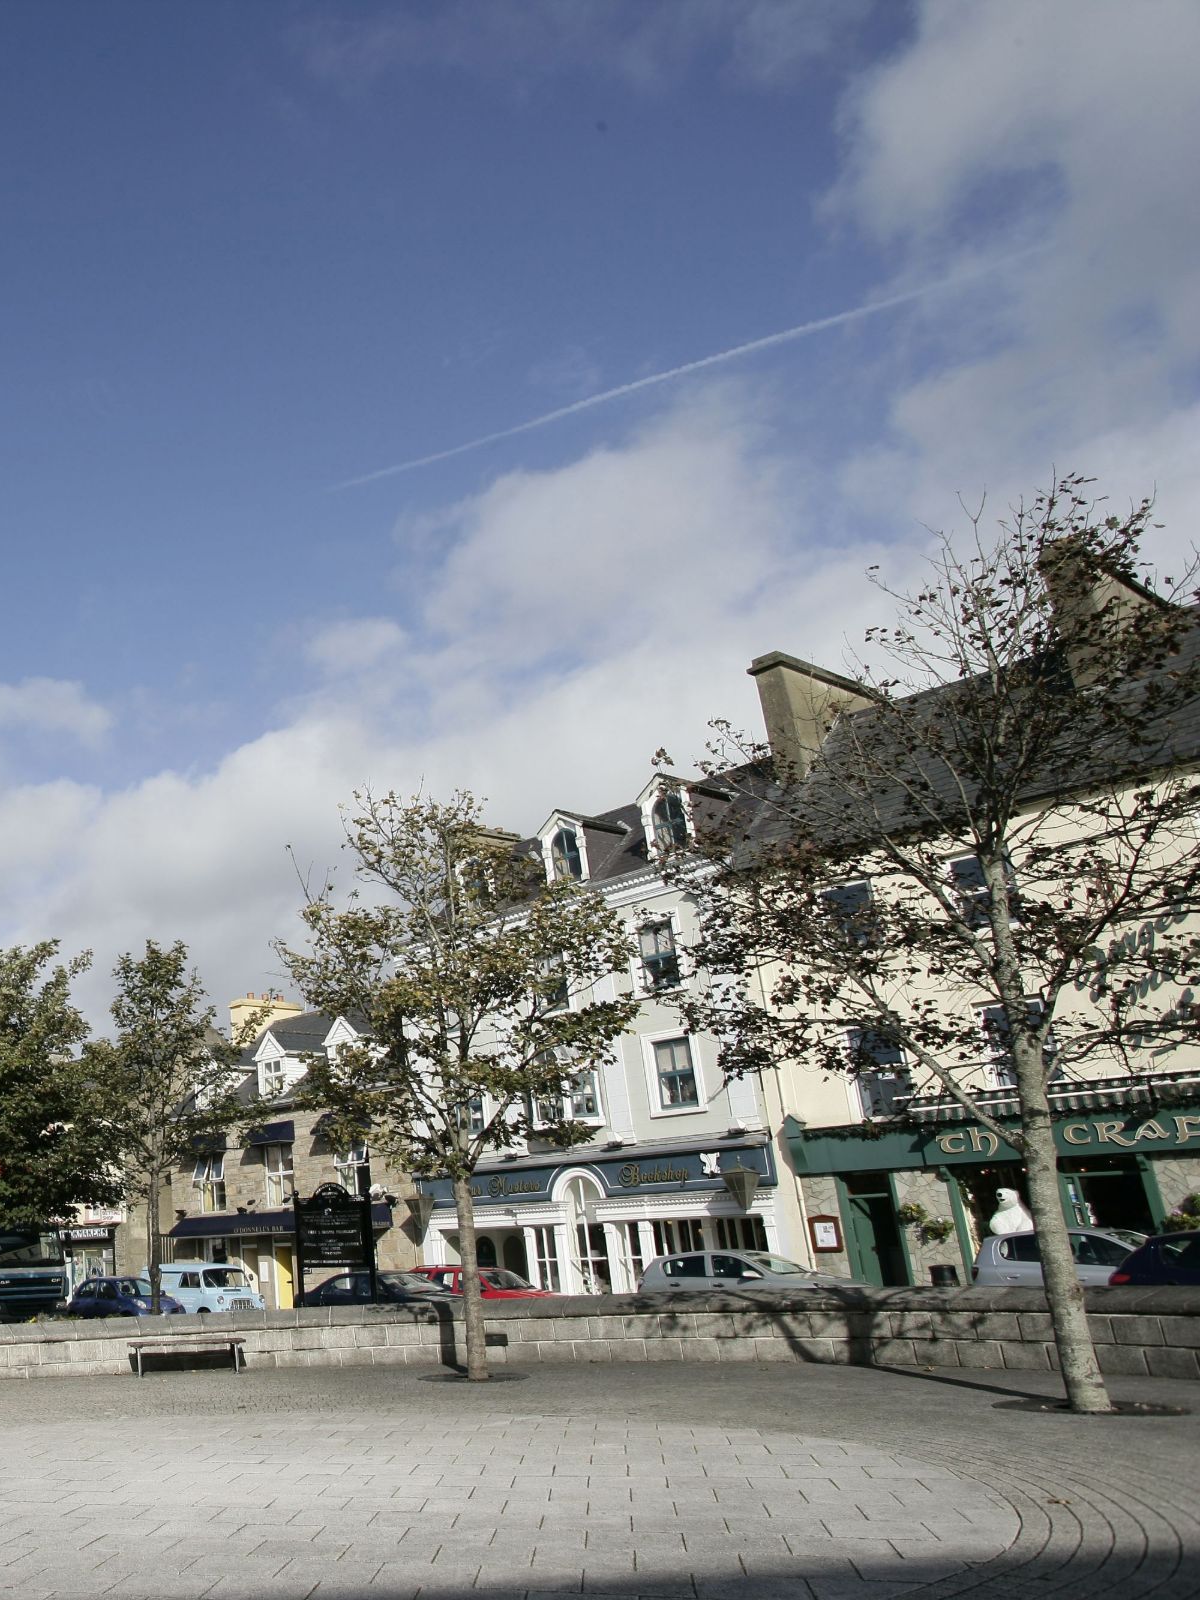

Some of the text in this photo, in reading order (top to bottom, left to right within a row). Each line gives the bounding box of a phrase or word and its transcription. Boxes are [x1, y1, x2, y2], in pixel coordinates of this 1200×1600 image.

[935, 1126, 1024, 1157] Th
[487, 1174, 540, 1198] Masters
[618, 1162, 689, 1188] Bookshop
